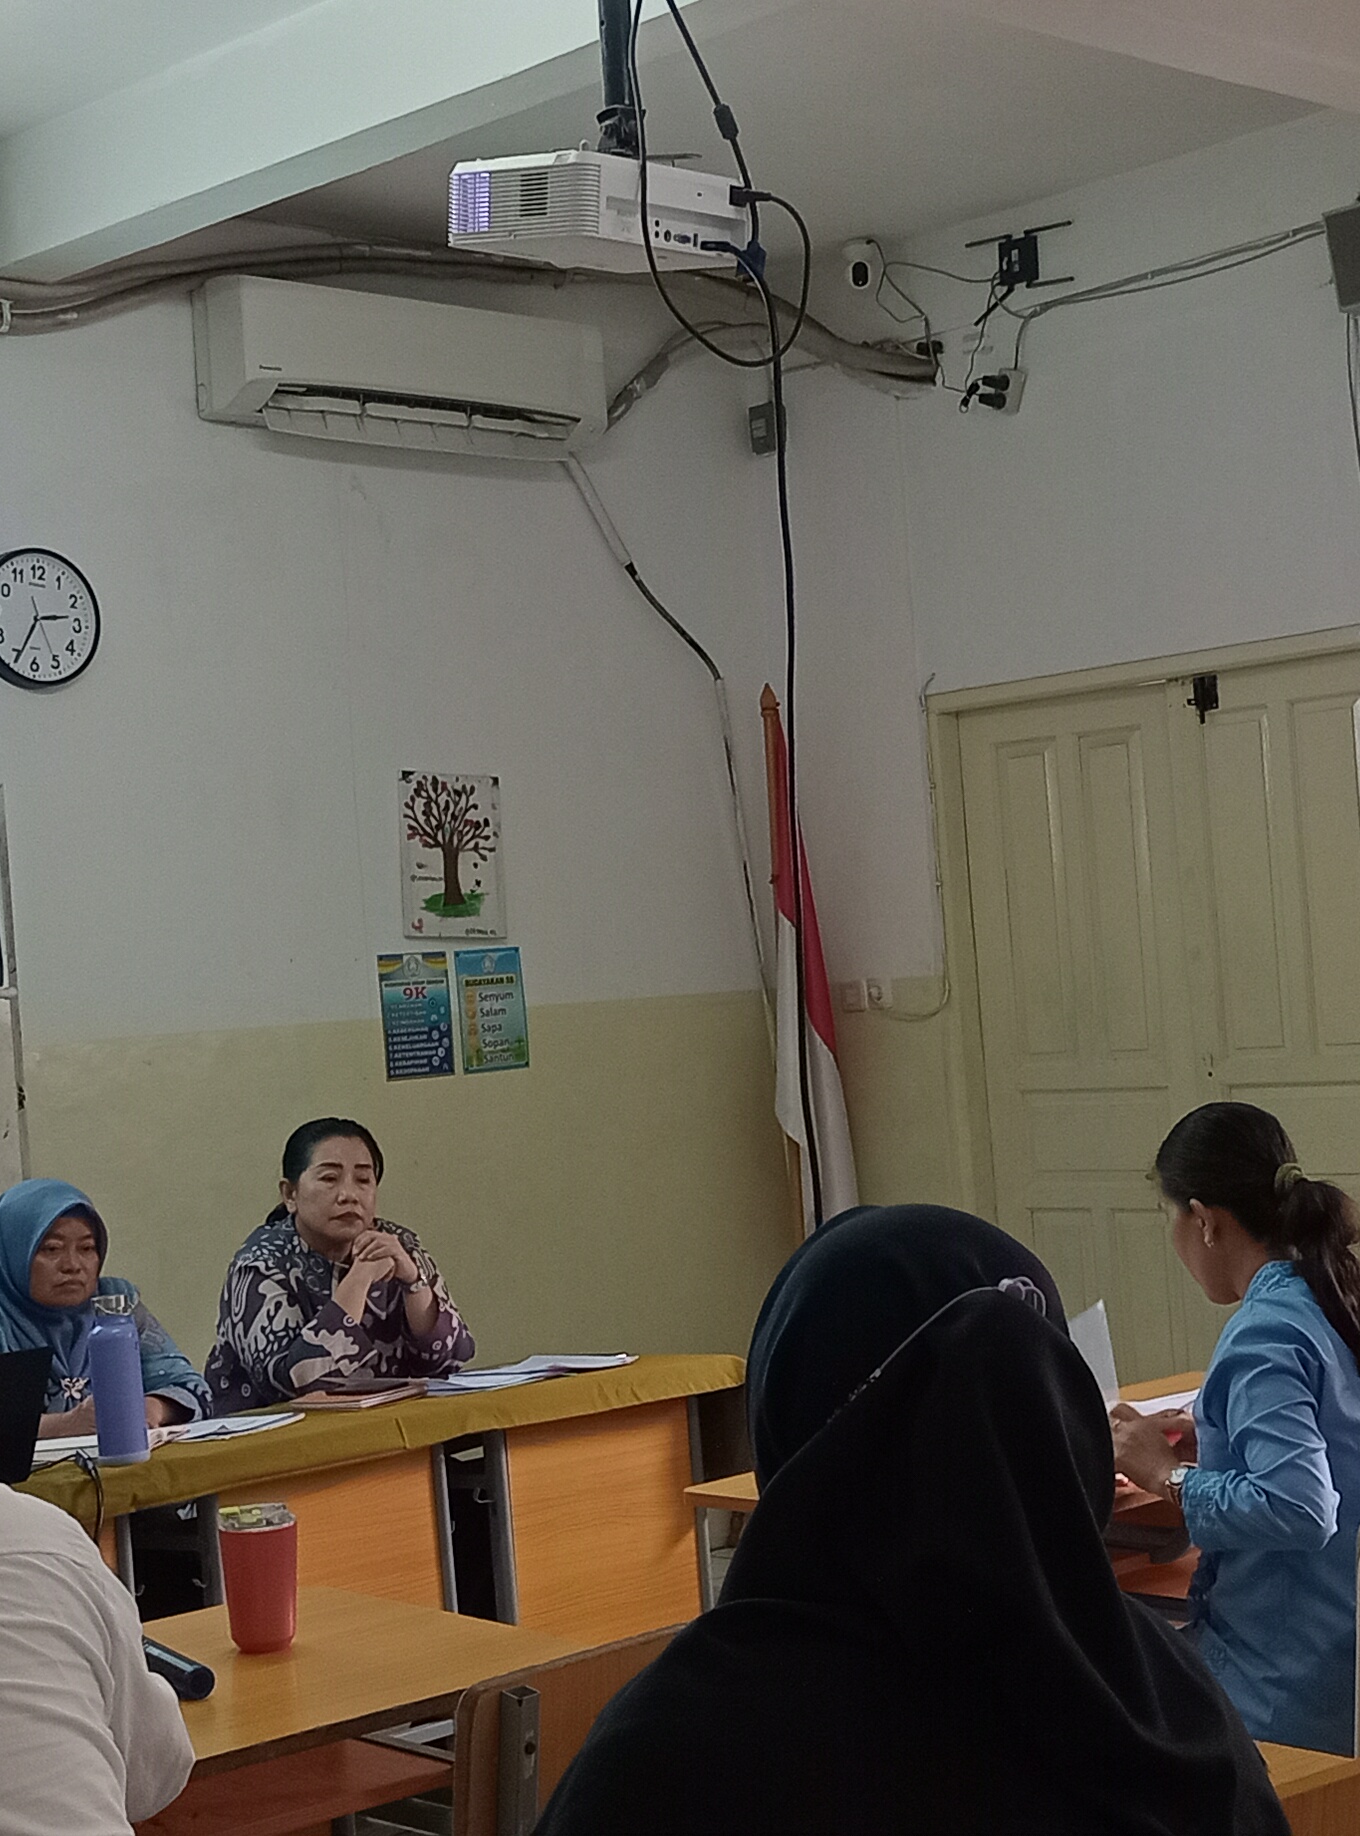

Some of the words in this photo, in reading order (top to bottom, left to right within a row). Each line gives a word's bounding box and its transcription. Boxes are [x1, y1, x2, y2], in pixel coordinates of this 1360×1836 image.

[11, 567, 24, 584] 11
[30, 564, 46, 581] 12
[55, 575, 61, 590] 1
[68, 594, 78, 609] 2
[72, 618, 82, 633] 3
[11, 647, 23, 663] 7
[65, 639, 76, 656] 4
[29, 656, 40, 672] 6
[50, 654, 60, 670] 5
[402, 986, 428, 1001] 9K
[479, 991, 515, 1004] Senyum
[480, 1007, 508, 1018] Salam
[481, 1023, 503, 1035] Sapa
[482, 1038, 510, 1050] Sopan
[484, 1053, 515, 1065] Santun
